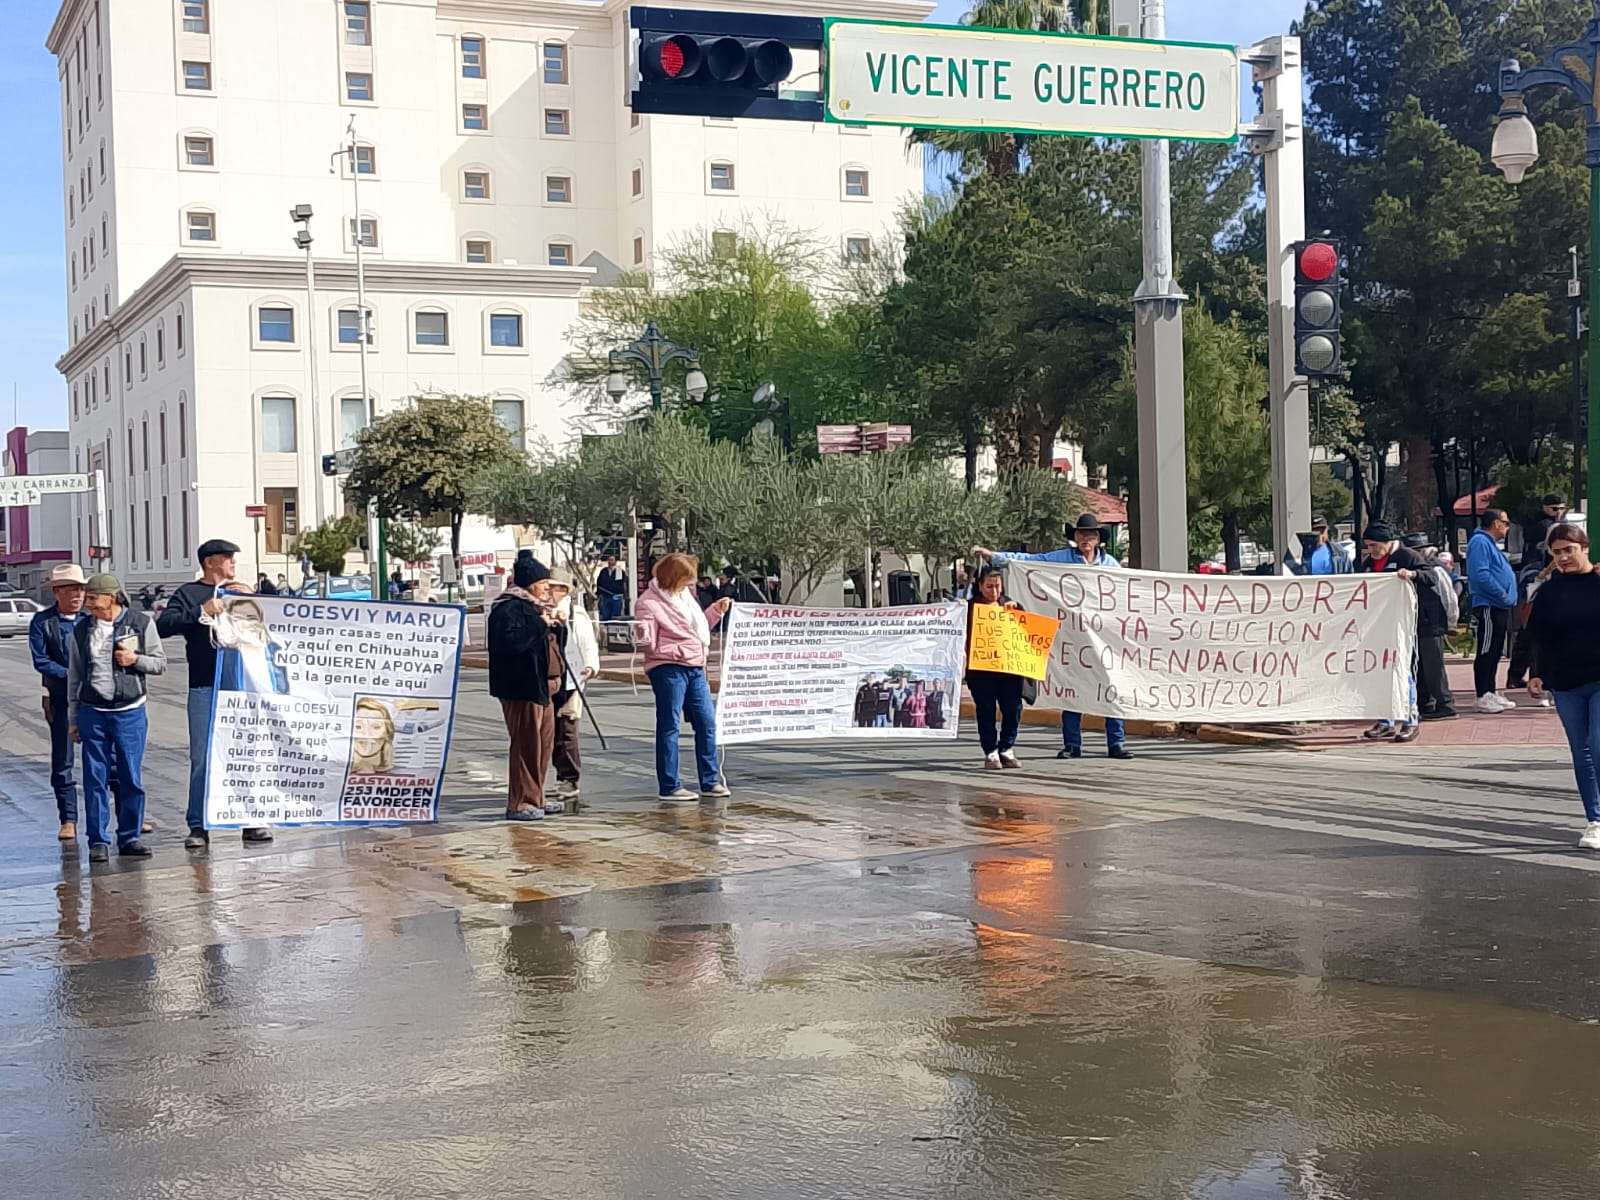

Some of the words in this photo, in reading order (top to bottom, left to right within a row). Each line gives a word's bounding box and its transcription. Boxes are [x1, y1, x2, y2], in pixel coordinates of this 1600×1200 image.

[866, 51, 1012, 101] VICENTE
[1033, 62, 1206, 111] GUERRERO
[11, 481, 18, 489] V
[23, 478, 84, 489] CARRANZA
[1025, 569, 1368, 615] GOBERNADORA
[283, 603, 360, 622] COESVI
[366, 609, 379, 623] Y
[385, 610, 447, 628] MARU
[753, 608, 805, 618] MARU
[977, 607, 1027, 625] LOERA
[734, 621, 752, 629] QUE
[809, 620, 825, 628] NOS
[975, 622, 1003, 637] TUS
[1057, 608, 1103, 633] PIDO
[1115, 616, 1149, 642] YA
[1168, 617, 1323, 646] SOLUCION
[1341, 618, 1362, 642] A
[268, 623, 334, 637] entregan
[339, 627, 382, 639] casas
[387, 631, 403, 641] en
[407, 631, 457, 645] Juárez
[284, 640, 293, 651] y
[297, 639, 331, 651] aquí
[335, 642, 353, 653] en
[358, 643, 439, 659] Chihuahua
[975, 637, 997, 649] DE
[973, 650, 1001, 660] AZUL
[1049, 641, 1300, 678] ECOMENDACION
[277, 653, 299, 665] NO
[305, 654, 376, 670] QUIEREN
[381, 661, 444, 674] APOYAR
[291, 671, 300, 681] a
[305, 670, 319, 682] la
[324, 672, 367, 685] gente
[372, 674, 390, 686] de
[395, 678, 428, 690] aquí
[294, 702, 339, 715] COESVI
[220, 715, 236, 724] no
[239, 715, 287, 728] quieren
[290, 721, 330, 732] apoyar
[334, 723, 342, 731] a
[231, 729, 243, 740] la
[288, 736, 302, 746] ya
[306, 737, 328, 748] que
[228, 746, 274, 758] quieres
[278, 747, 318, 761] lanzar
[226, 762, 262, 774] puros
[265, 762, 326, 776] corruptos
[222, 778, 256, 788] como
[259, 778, 325, 789] candidatos
[347, 777, 392, 786] GASTA
[395, 777, 436, 787] MARU
[345, 786, 373, 796] 253
[376, 786, 411, 797] MDP
[412, 786, 434, 797] EN
[227, 794, 256, 806] para
[259, 795, 280, 806] que
[284, 793, 316, 804] sigan
[343, 796, 431, 808] FAVORECER
[216, 808, 265, 820] robando
[269, 808, 280, 818] al
[343, 807, 365, 819] SU
[368, 807, 431, 819] IMAGEN
